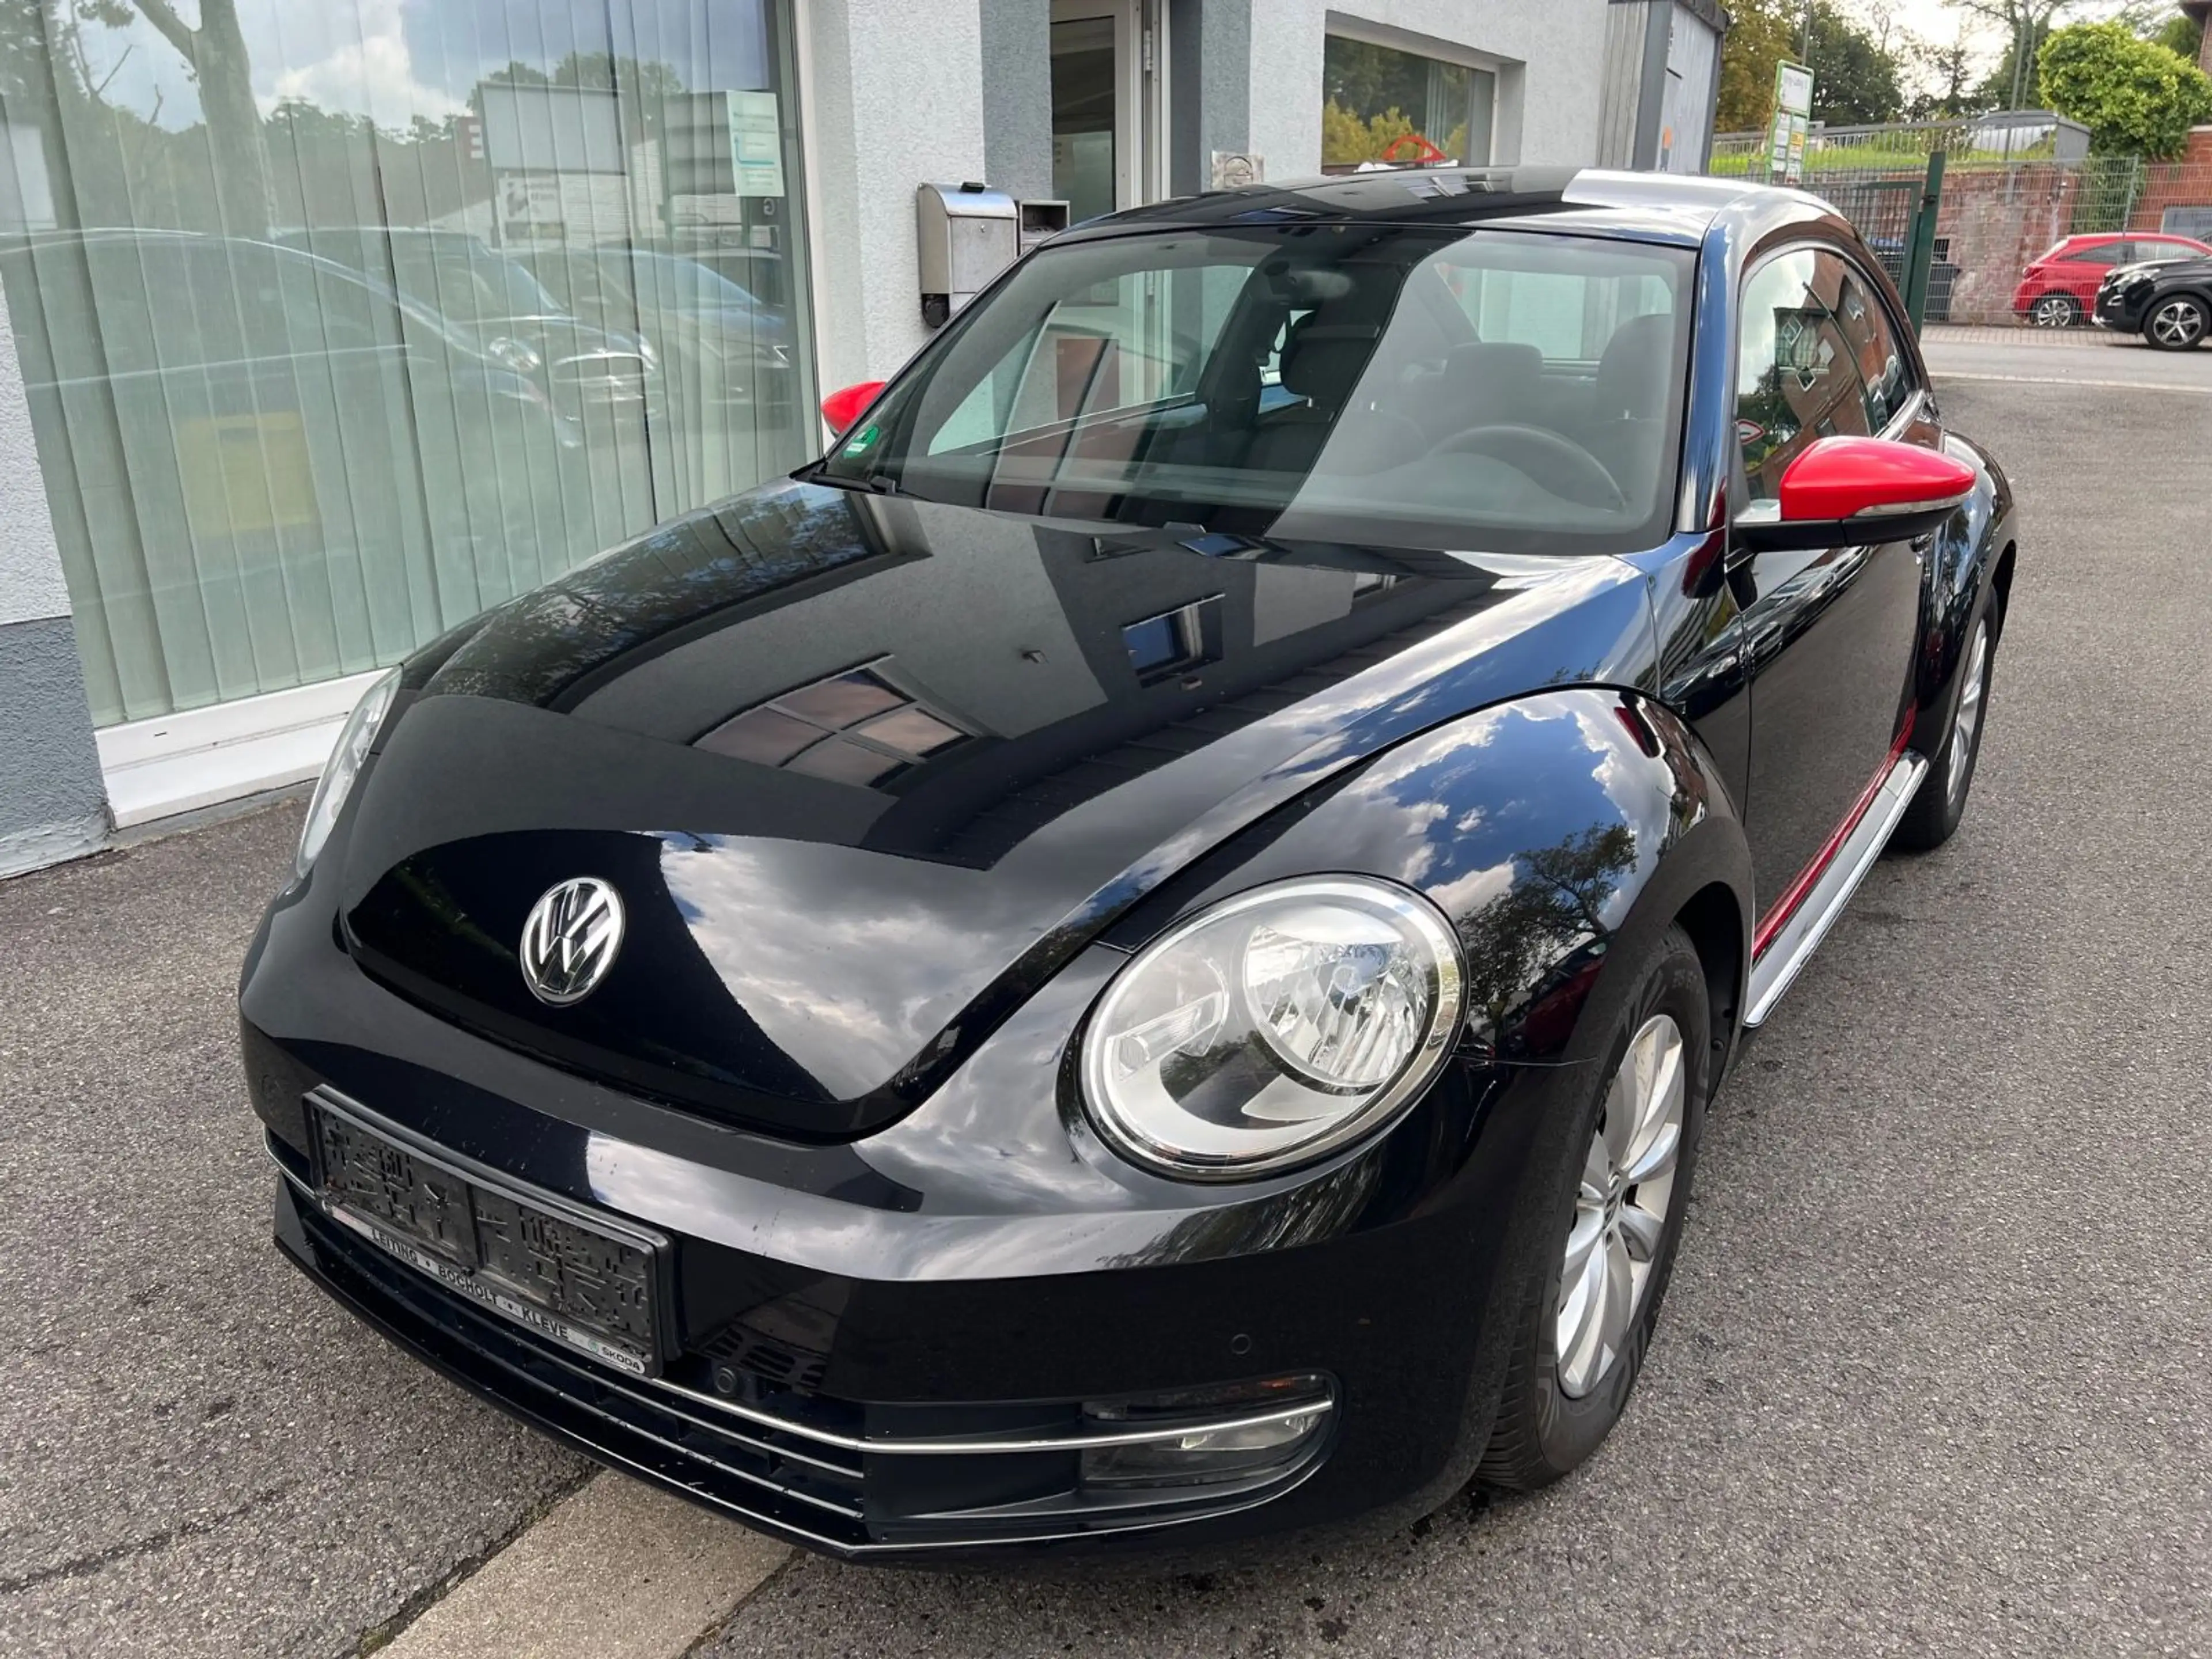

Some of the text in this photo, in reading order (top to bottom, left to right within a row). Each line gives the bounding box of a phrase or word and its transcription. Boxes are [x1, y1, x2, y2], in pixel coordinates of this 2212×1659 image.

[521, 878, 624, 1006] VW
[438, 1264, 498, 1305] BOCHOLT
[521, 1306, 569, 1339] KLEVE
